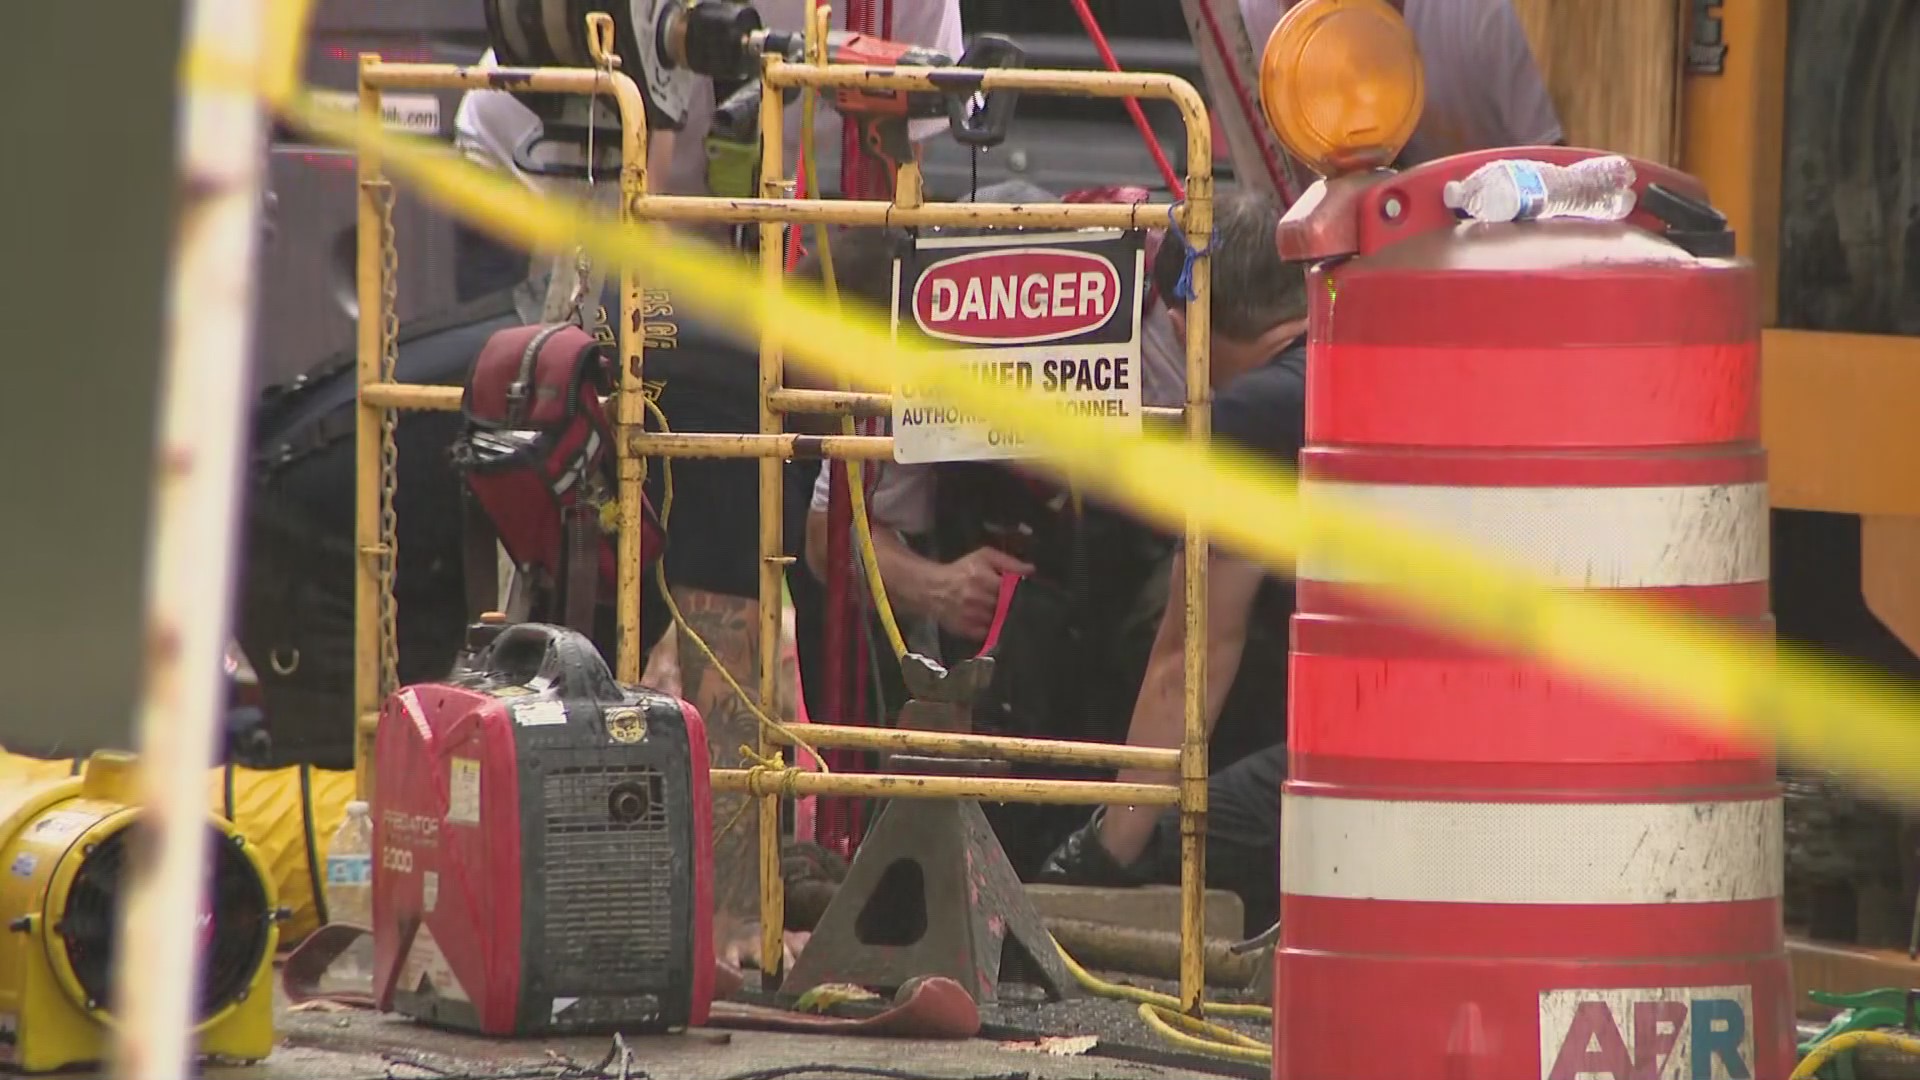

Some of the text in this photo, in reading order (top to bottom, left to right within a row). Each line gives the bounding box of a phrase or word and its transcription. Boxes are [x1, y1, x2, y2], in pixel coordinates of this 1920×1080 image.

[930, 271, 1107, 323] DANGER
[901, 357, 1130, 399] INED SPACE
[902, 398, 1130, 427] AUTHO ONNEL
[987, 427, 1026, 447] ONL
